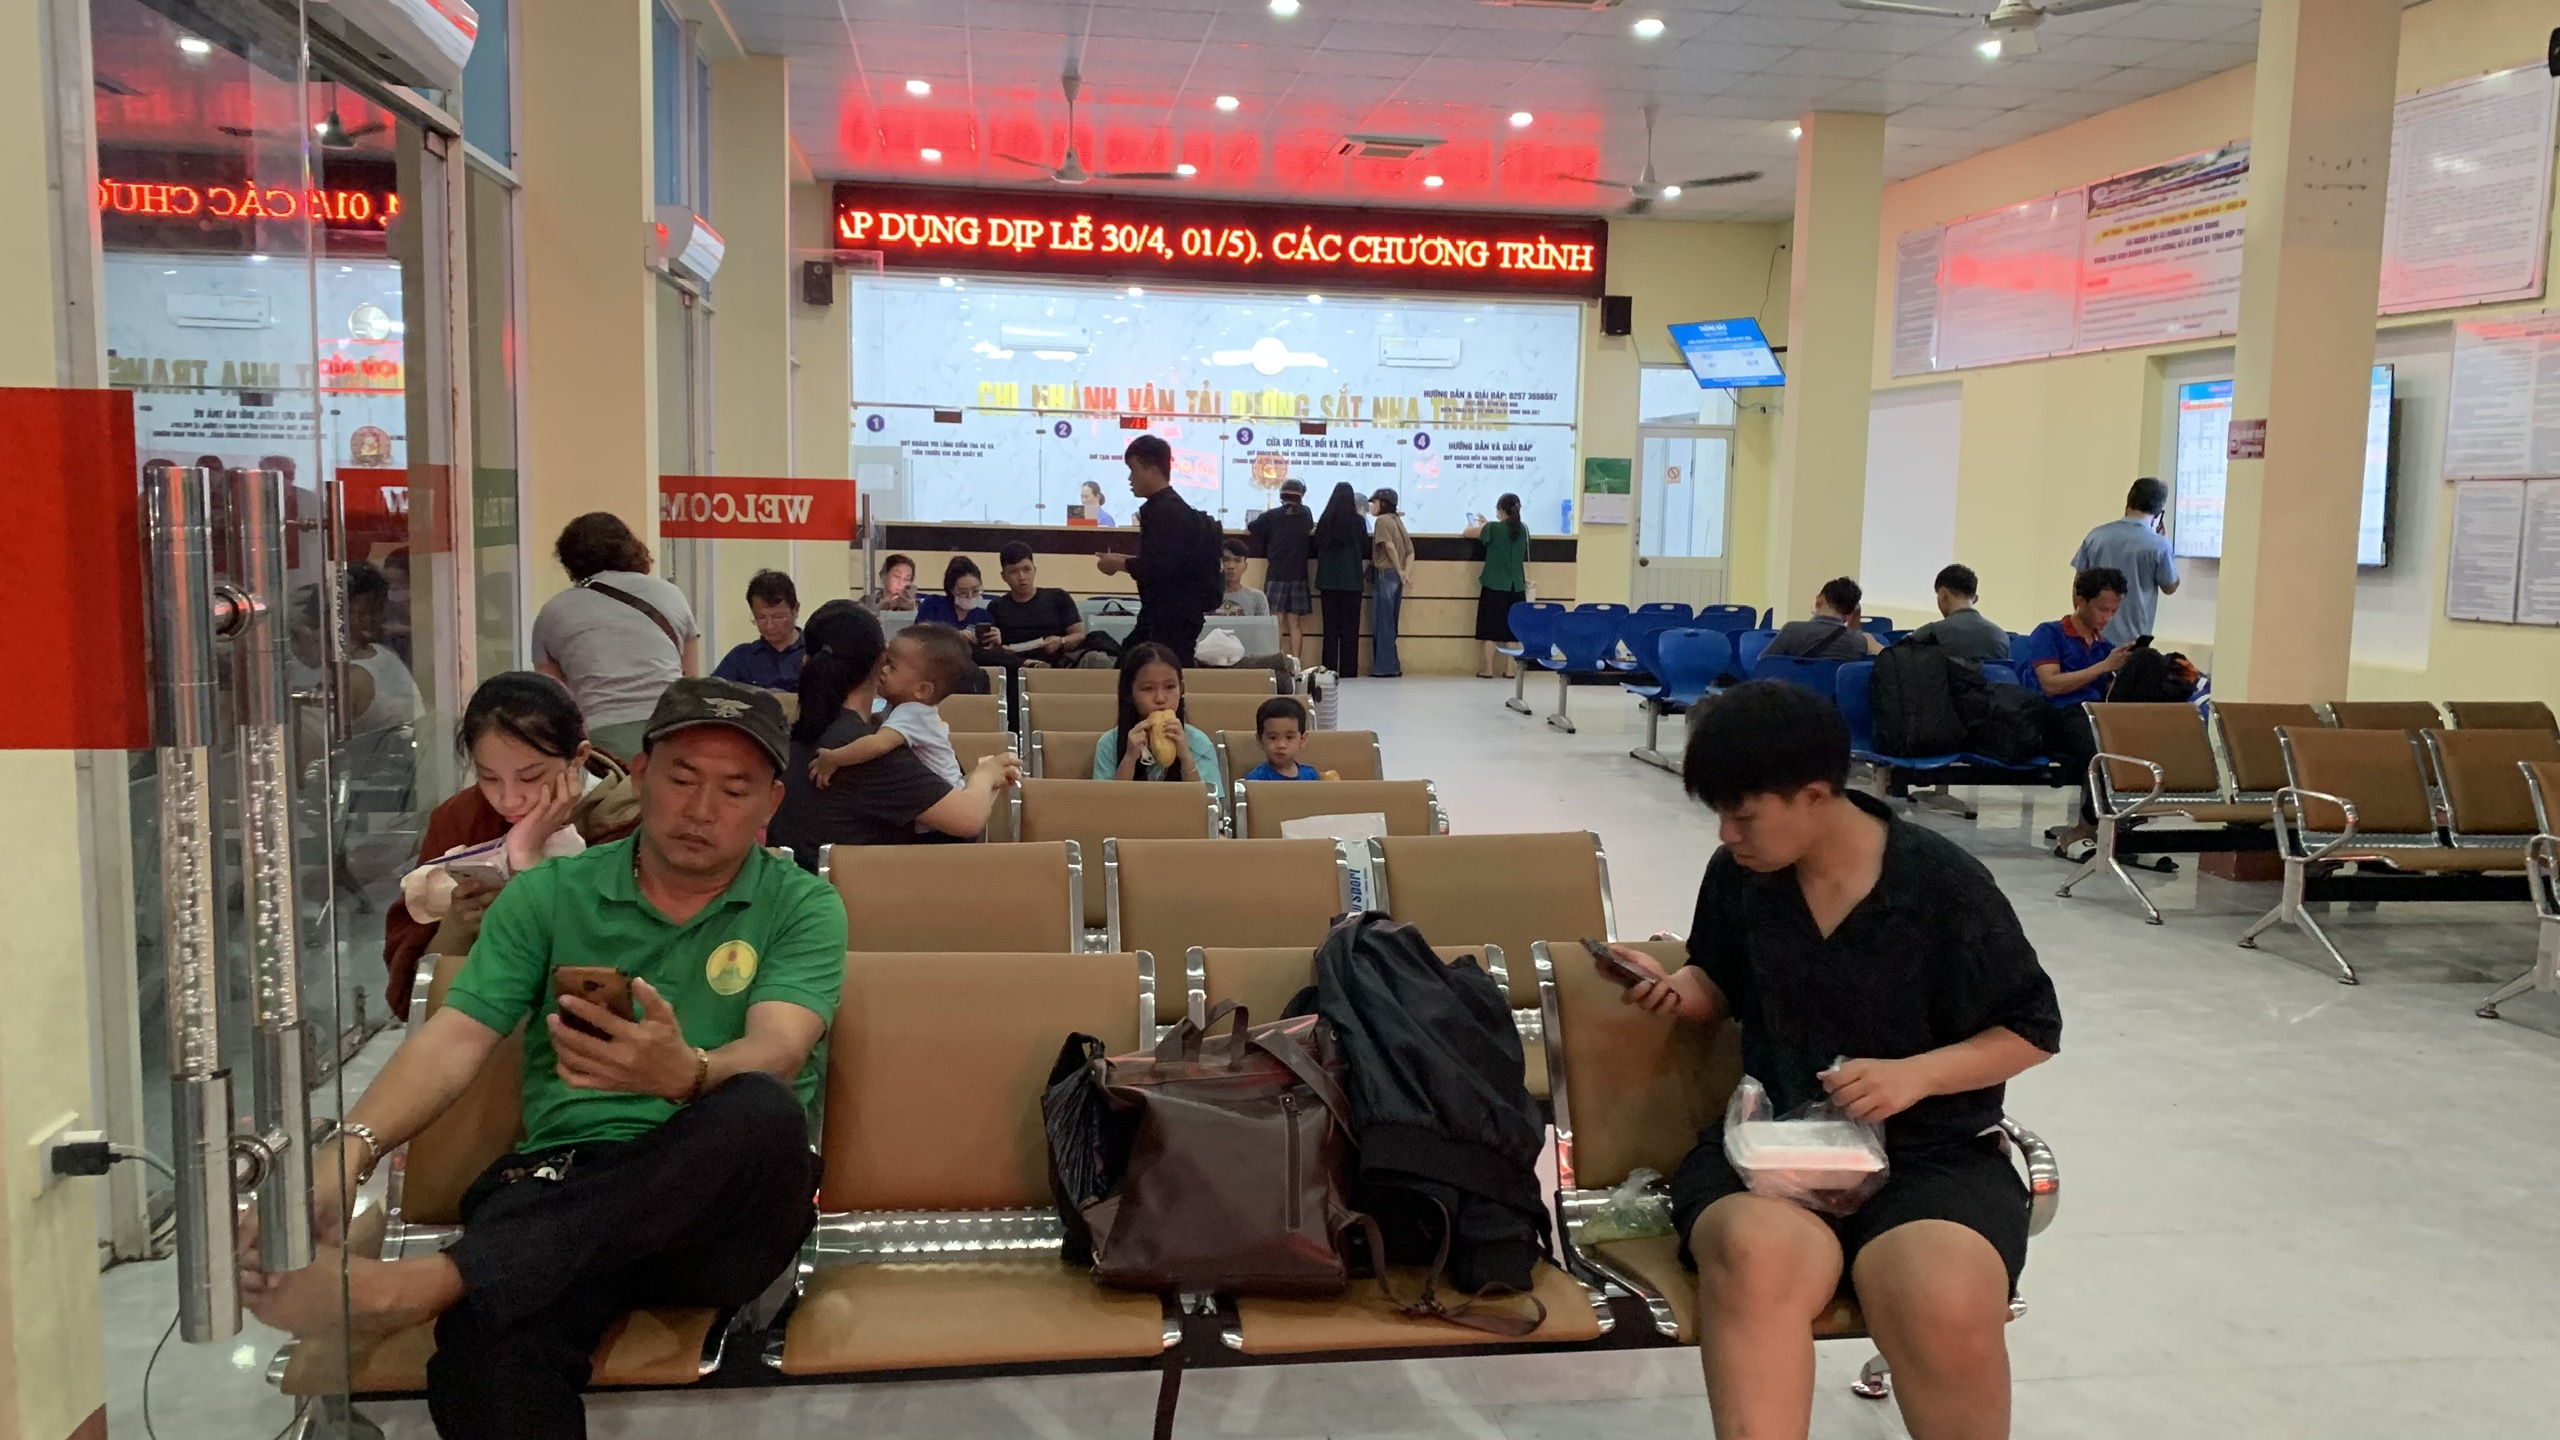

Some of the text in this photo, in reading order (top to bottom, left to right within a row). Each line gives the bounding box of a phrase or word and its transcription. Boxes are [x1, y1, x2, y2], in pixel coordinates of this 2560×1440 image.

[879, 212, 982, 247] DỤNG
[988, 217, 1044, 252] DỊP
[1049, 214, 1095, 250] LỄ
[1101, 223, 1174, 260] 30/4,
[1181, 227, 1263, 264] 01/5).
[1272, 225, 1342, 263] CÁC
[1348, 232, 1490, 268] CHƯƠNG
[1497, 235, 1594, 272] TRÌNH
[978, 381, 1019, 416] CHI
[1031, 379, 1117, 418] NHÁNH
[1320, 383, 1363, 428] SẮT
[1372, 396, 1421, 430] NHA
